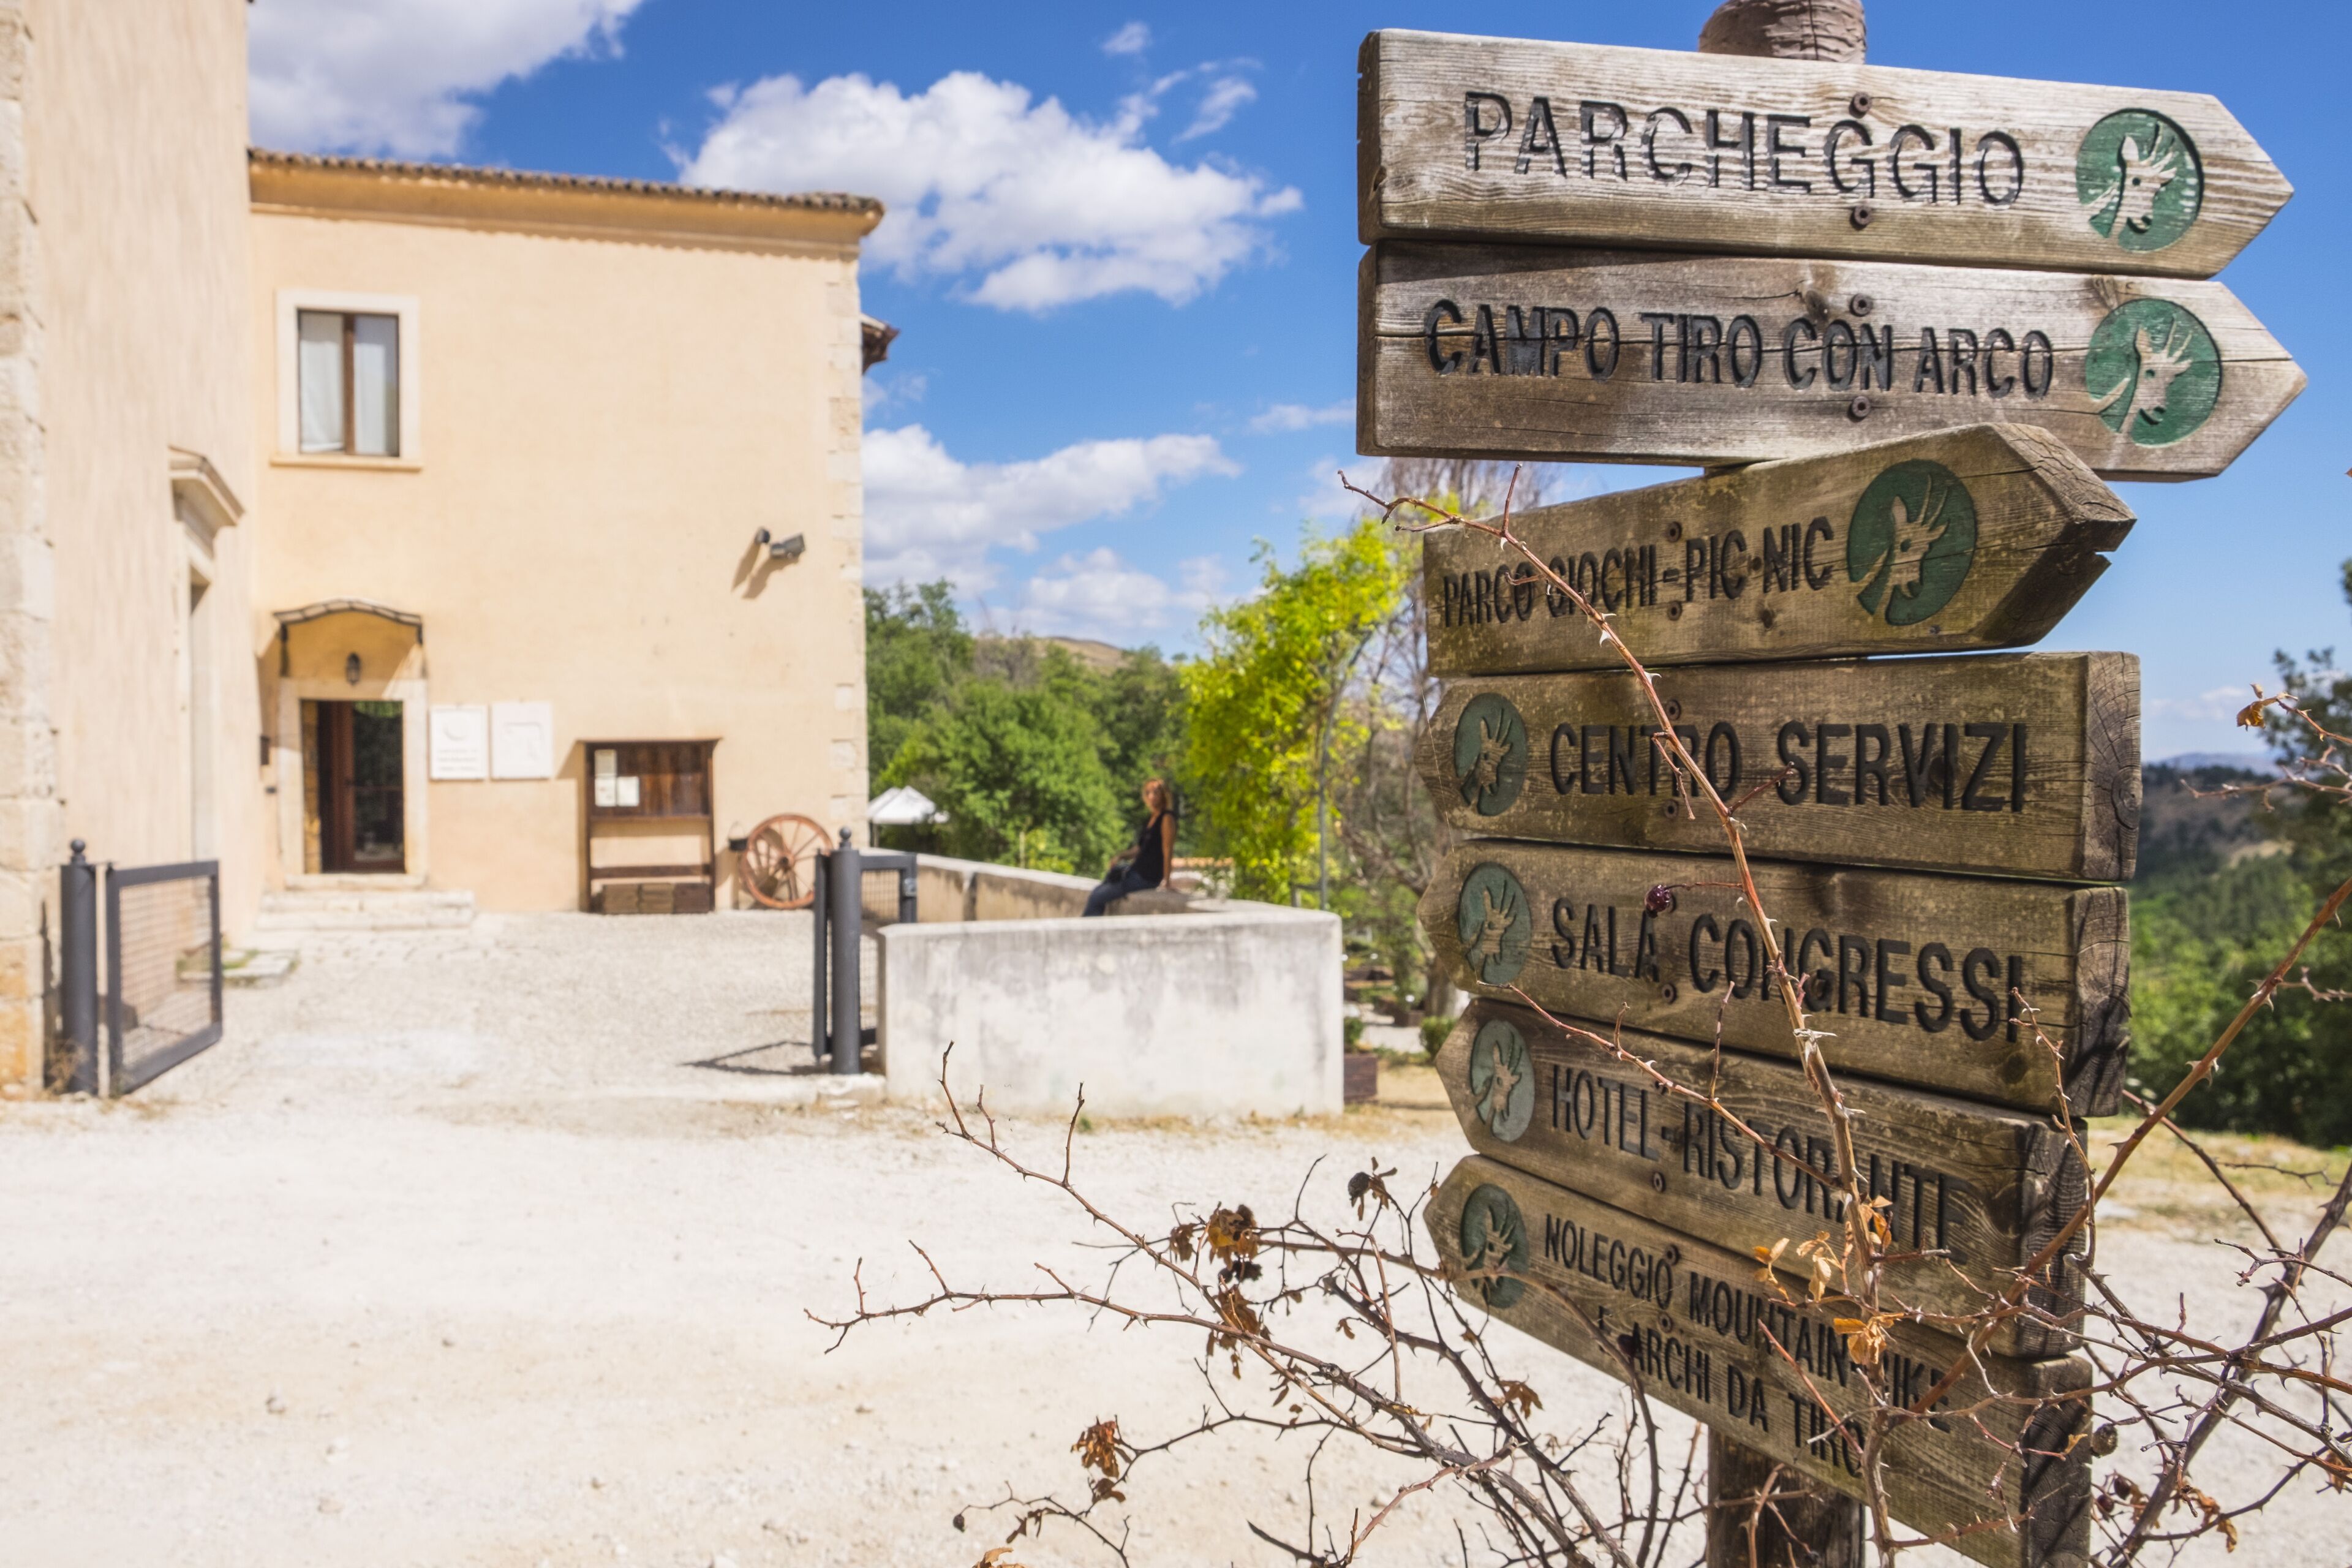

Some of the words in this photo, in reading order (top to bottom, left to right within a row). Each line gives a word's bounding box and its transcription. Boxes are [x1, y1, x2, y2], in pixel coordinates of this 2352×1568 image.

[1464, 91, 2024, 207] PARCHEGGIO
[1424, 299, 1620, 383] CAMPO
[1639, 310, 1764, 390] TIRO
[1781, 317, 1894, 392] CON
[1912, 326, 2054, 399] ARCO
[1444, 562, 1533, 628] PARCO
[1550, 720, 1743, 804] CENTRO
[1776, 720, 2027, 813] SERVIZI
[1551, 897, 1661, 983] SALA
[1689, 913, 2023, 1044] CONGRESSI
[1545, 1213, 1675, 1310] NOLEGGIO
[1727, 1363, 1770, 1433] DA
